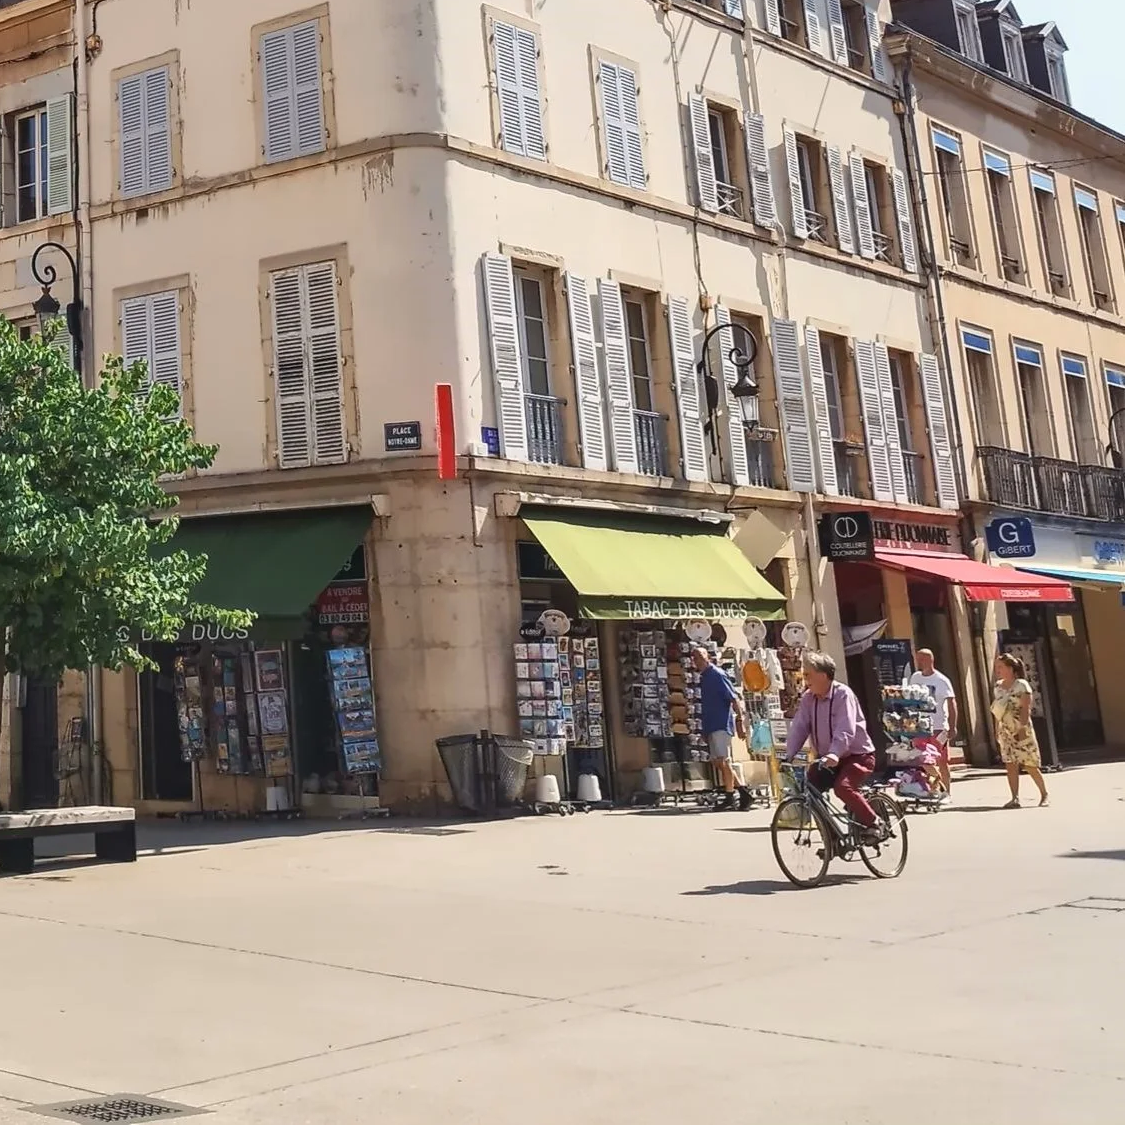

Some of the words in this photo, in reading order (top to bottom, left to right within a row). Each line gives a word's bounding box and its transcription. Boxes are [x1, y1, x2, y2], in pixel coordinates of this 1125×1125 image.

[392, 426, 412, 435] PLACE
[387, 436, 417, 446] NOTRE-DAME
[998, 522, 1020, 544] G
[334, 586, 363, 596] VENDRE
[624, 600, 671, 618] TABAC
[678, 601, 706, 618] DES
[711, 602, 748, 619] DUCS
[192, 625, 249, 641] DUCS
